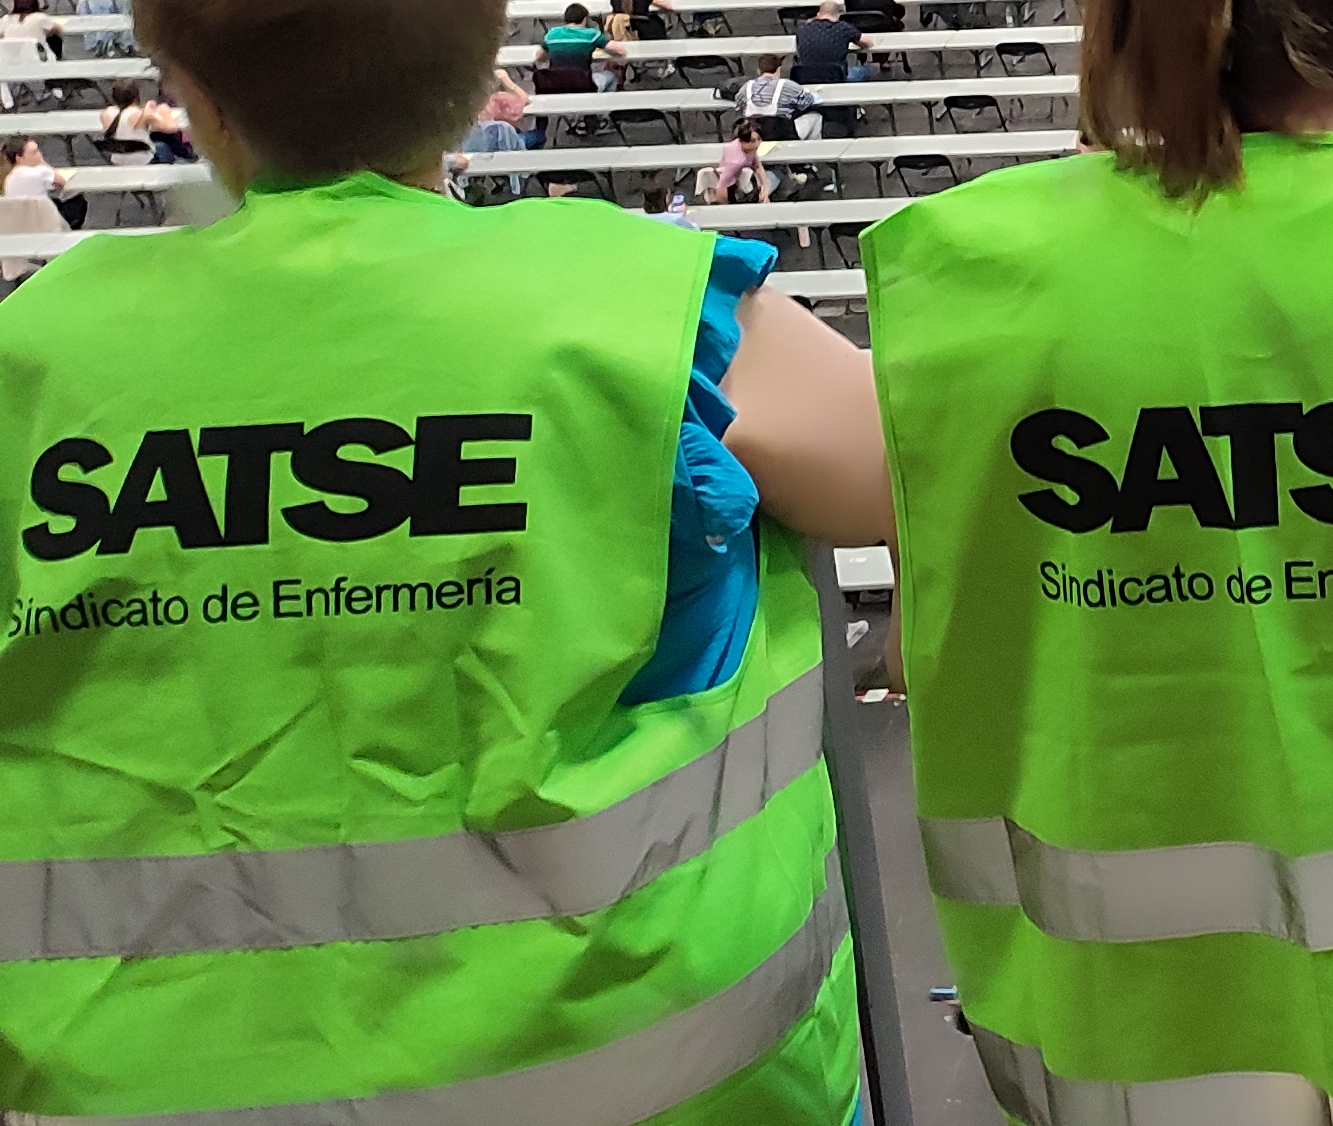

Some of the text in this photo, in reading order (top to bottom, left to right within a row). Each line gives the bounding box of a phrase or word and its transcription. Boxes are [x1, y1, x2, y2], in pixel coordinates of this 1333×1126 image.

[22, 412, 533, 563] SATSE
[8, 568, 522, 639] Sindicato de Enfermería
[1040, 560, 1215, 609] Sindicato
[1226, 566, 1273, 605] de
